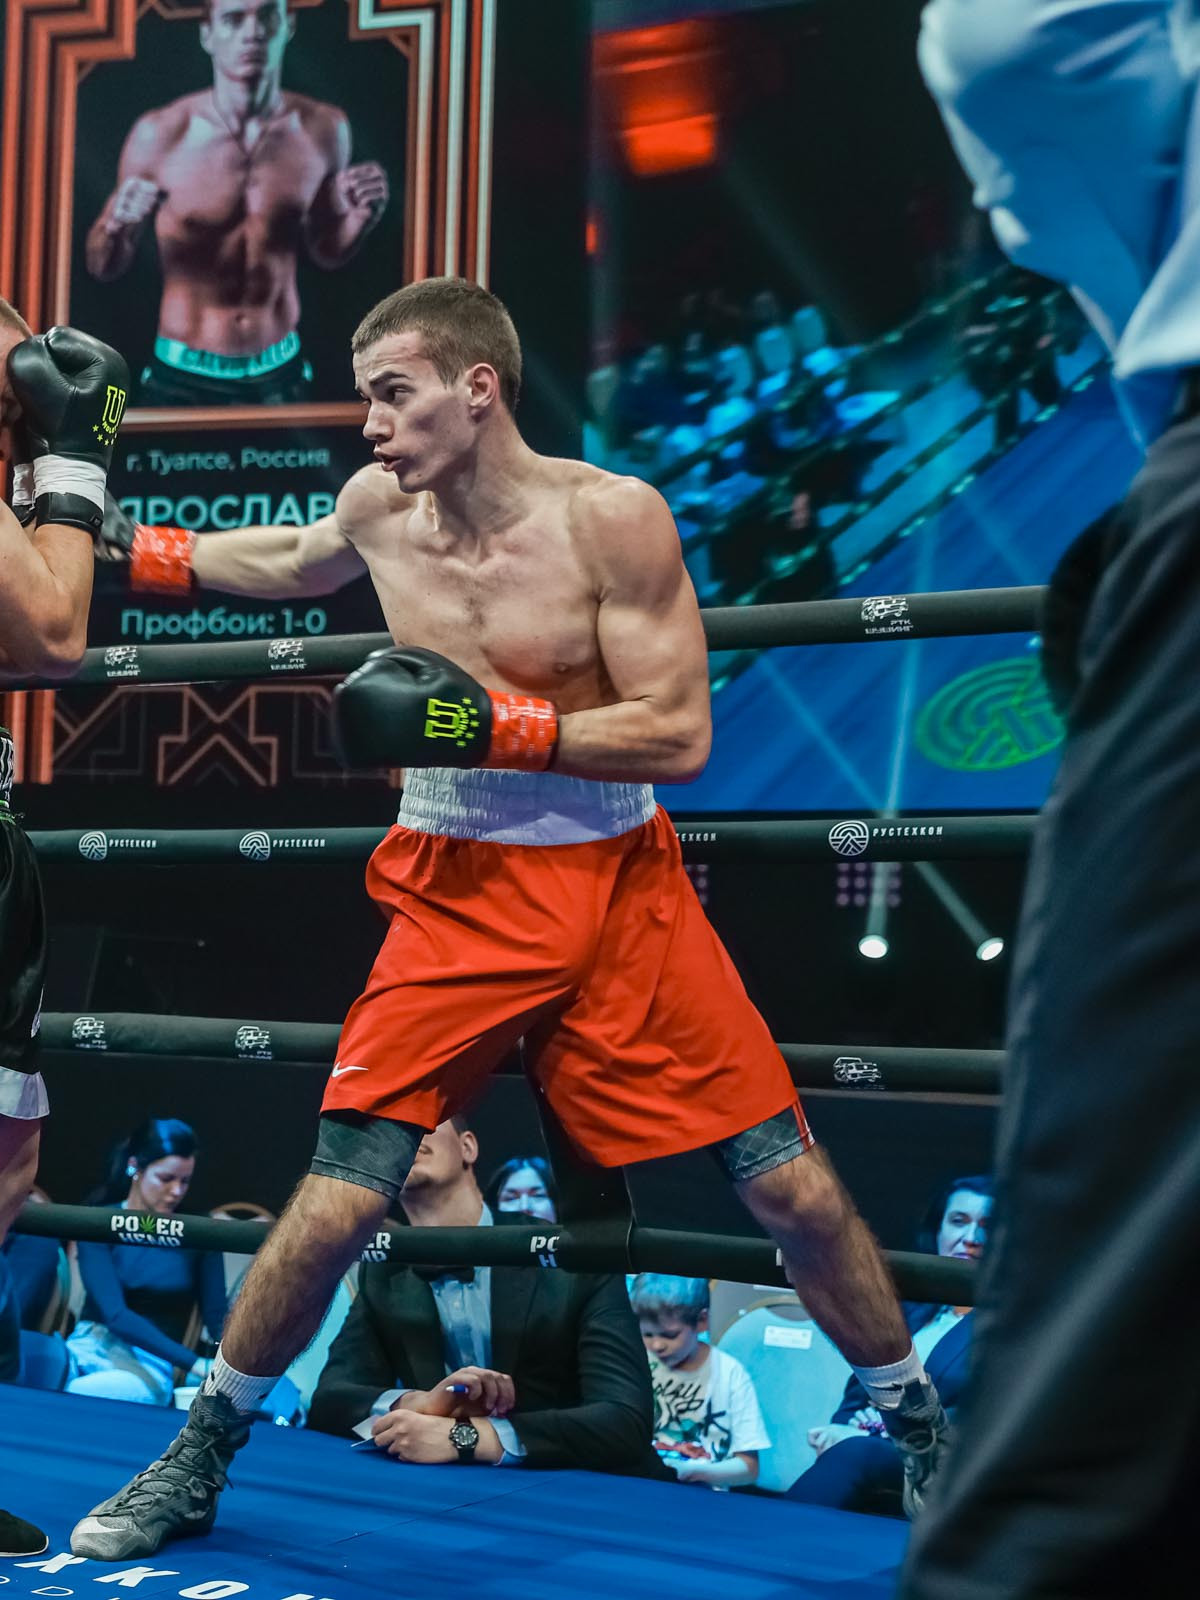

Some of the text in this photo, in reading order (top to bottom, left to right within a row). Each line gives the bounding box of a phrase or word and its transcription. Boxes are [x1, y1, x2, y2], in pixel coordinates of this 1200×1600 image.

[147, 451, 236, 475] Туапсе,
[241, 447, 330, 468] Россия
[281, 607, 327, 635] 1-0
[676, 832, 717, 842] ЕХКОН
[872, 826, 944, 837] РУСТЕХКОН
